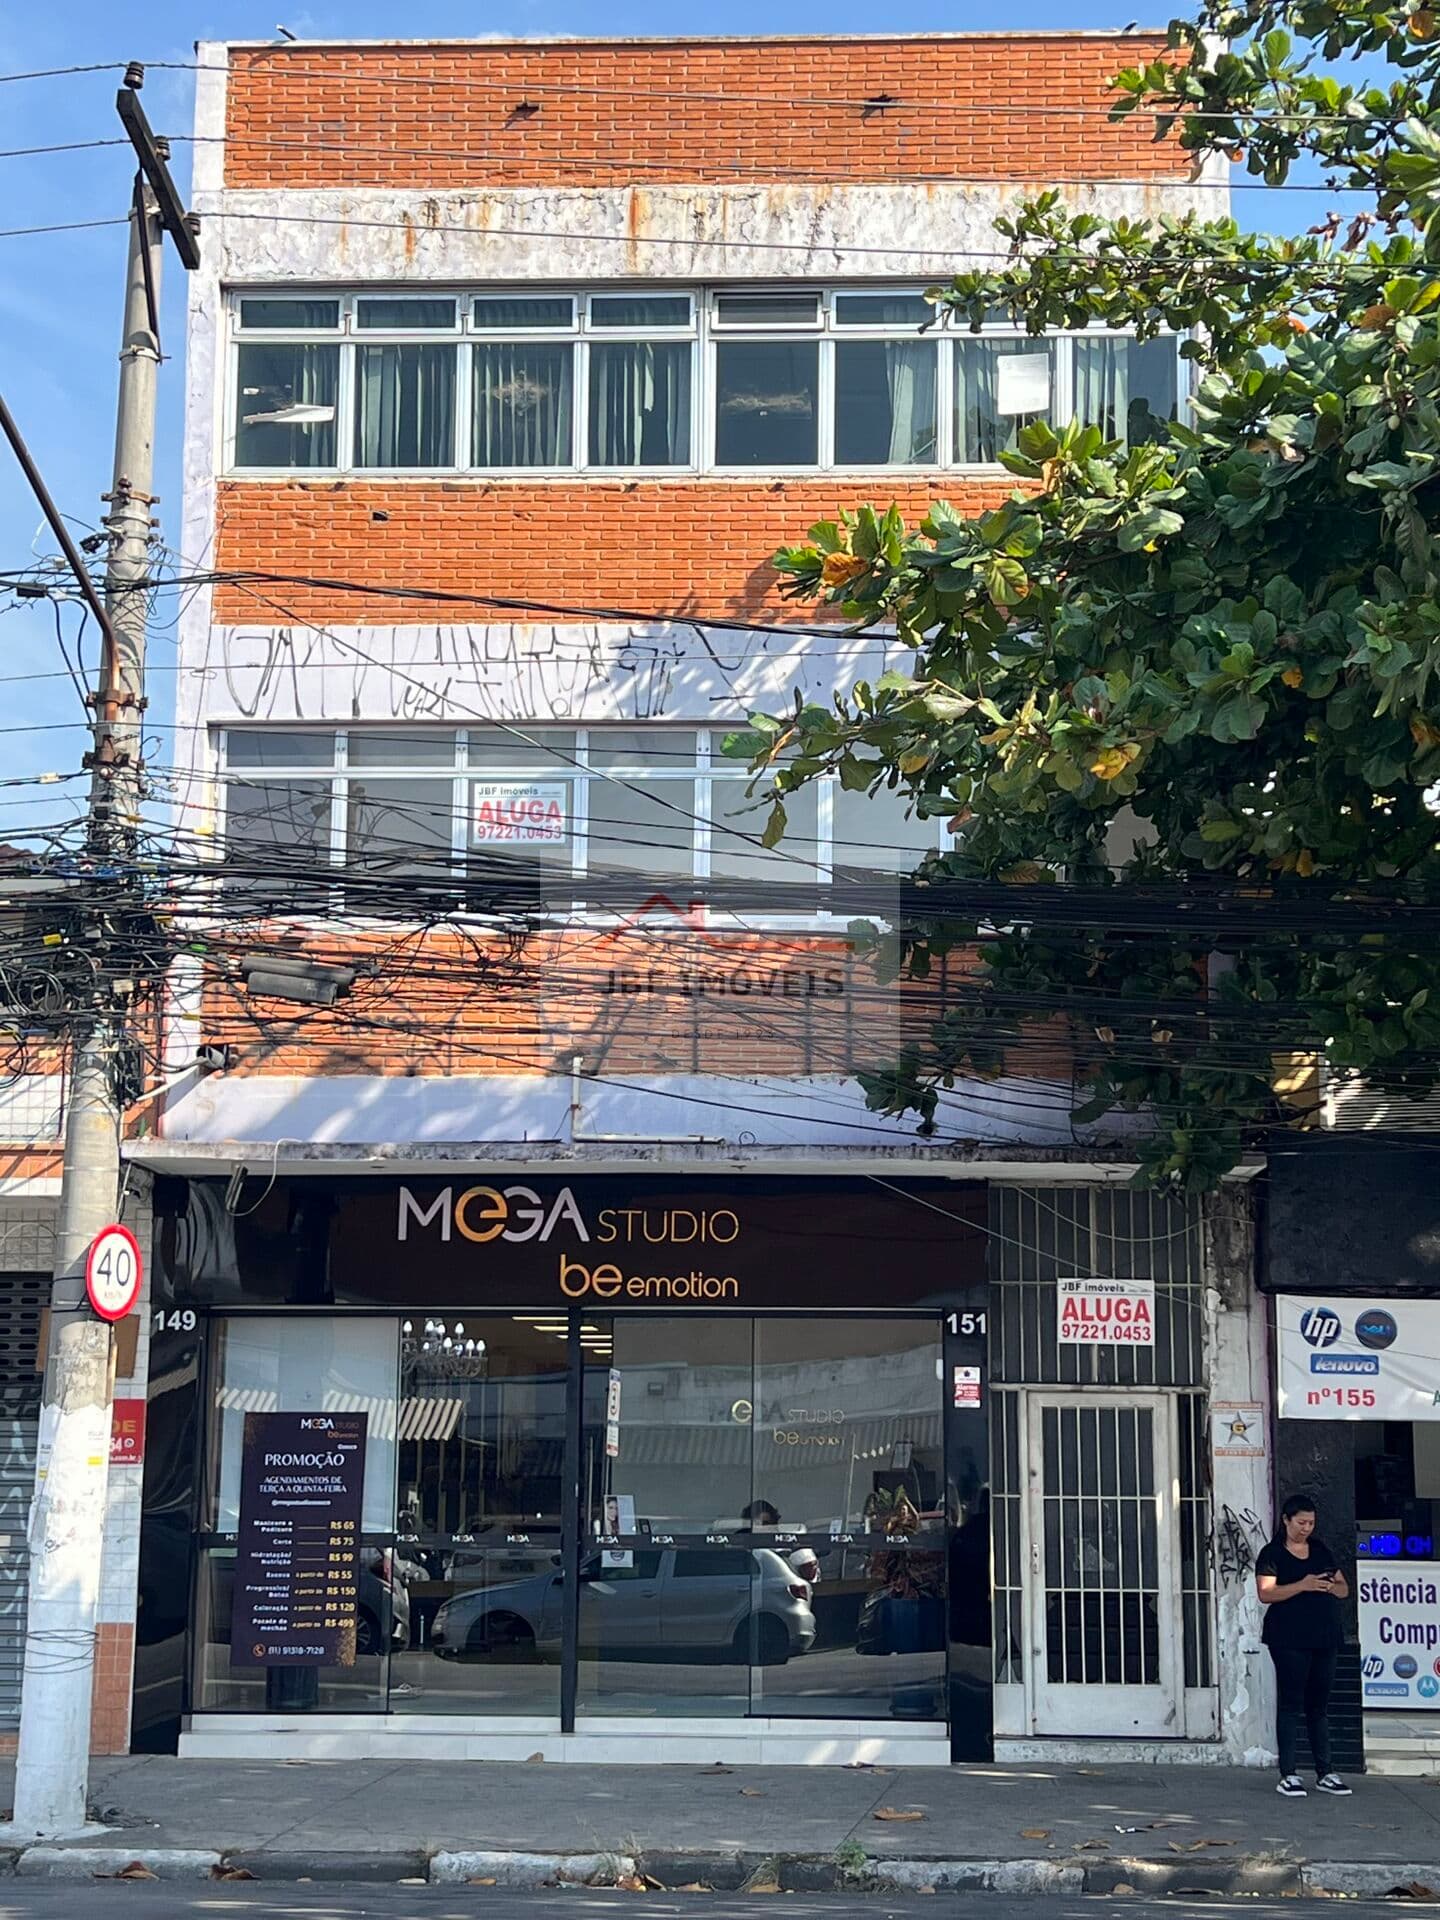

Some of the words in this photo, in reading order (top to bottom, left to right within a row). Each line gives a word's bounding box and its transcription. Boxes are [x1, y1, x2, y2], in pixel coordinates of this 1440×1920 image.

[479, 786, 498, 796] JBF
[479, 799, 562, 823] ALUGA
[478, 825, 562, 839] 97221.0453
[596, 1209, 740, 1243] STUDIO
[97, 1247, 131, 1287] 40
[560, 1253, 623, 1298] be
[625, 1271, 739, 1298] emotion
[1062, 1281, 1082, 1292] JBF
[1062, 1297, 1151, 1323] ALUGA
[154, 1310, 197, 1332] 149
[946, 1312, 987, 1335] 151
[1304, 1307, 1338, 1348] hp
[1062, 1323, 1152, 1341] 97221.0453
[1315, 1356, 1376, 1373] lenovo
[774, 1427, 800, 1445] be
[264, 1452, 344, 1468] PROMOÇÃO
[259, 1484, 285, 1494] TERÇA
[293, 1484, 347, 1493] QUINTA-FEIRA
[343, 1520, 355, 1530] 65
[342, 1536, 354, 1546] 75
[342, 1552, 354, 1562] 99
[340, 1570, 353, 1580] 55
[340, 1586, 357, 1596] 150
[1359, 1576, 1437, 1604] stência
[253, 1604, 289, 1612] Coloração
[339, 1602, 356, 1612] 120
[337, 1618, 355, 1629] 499
[1362, 1655, 1383, 1678] hp
